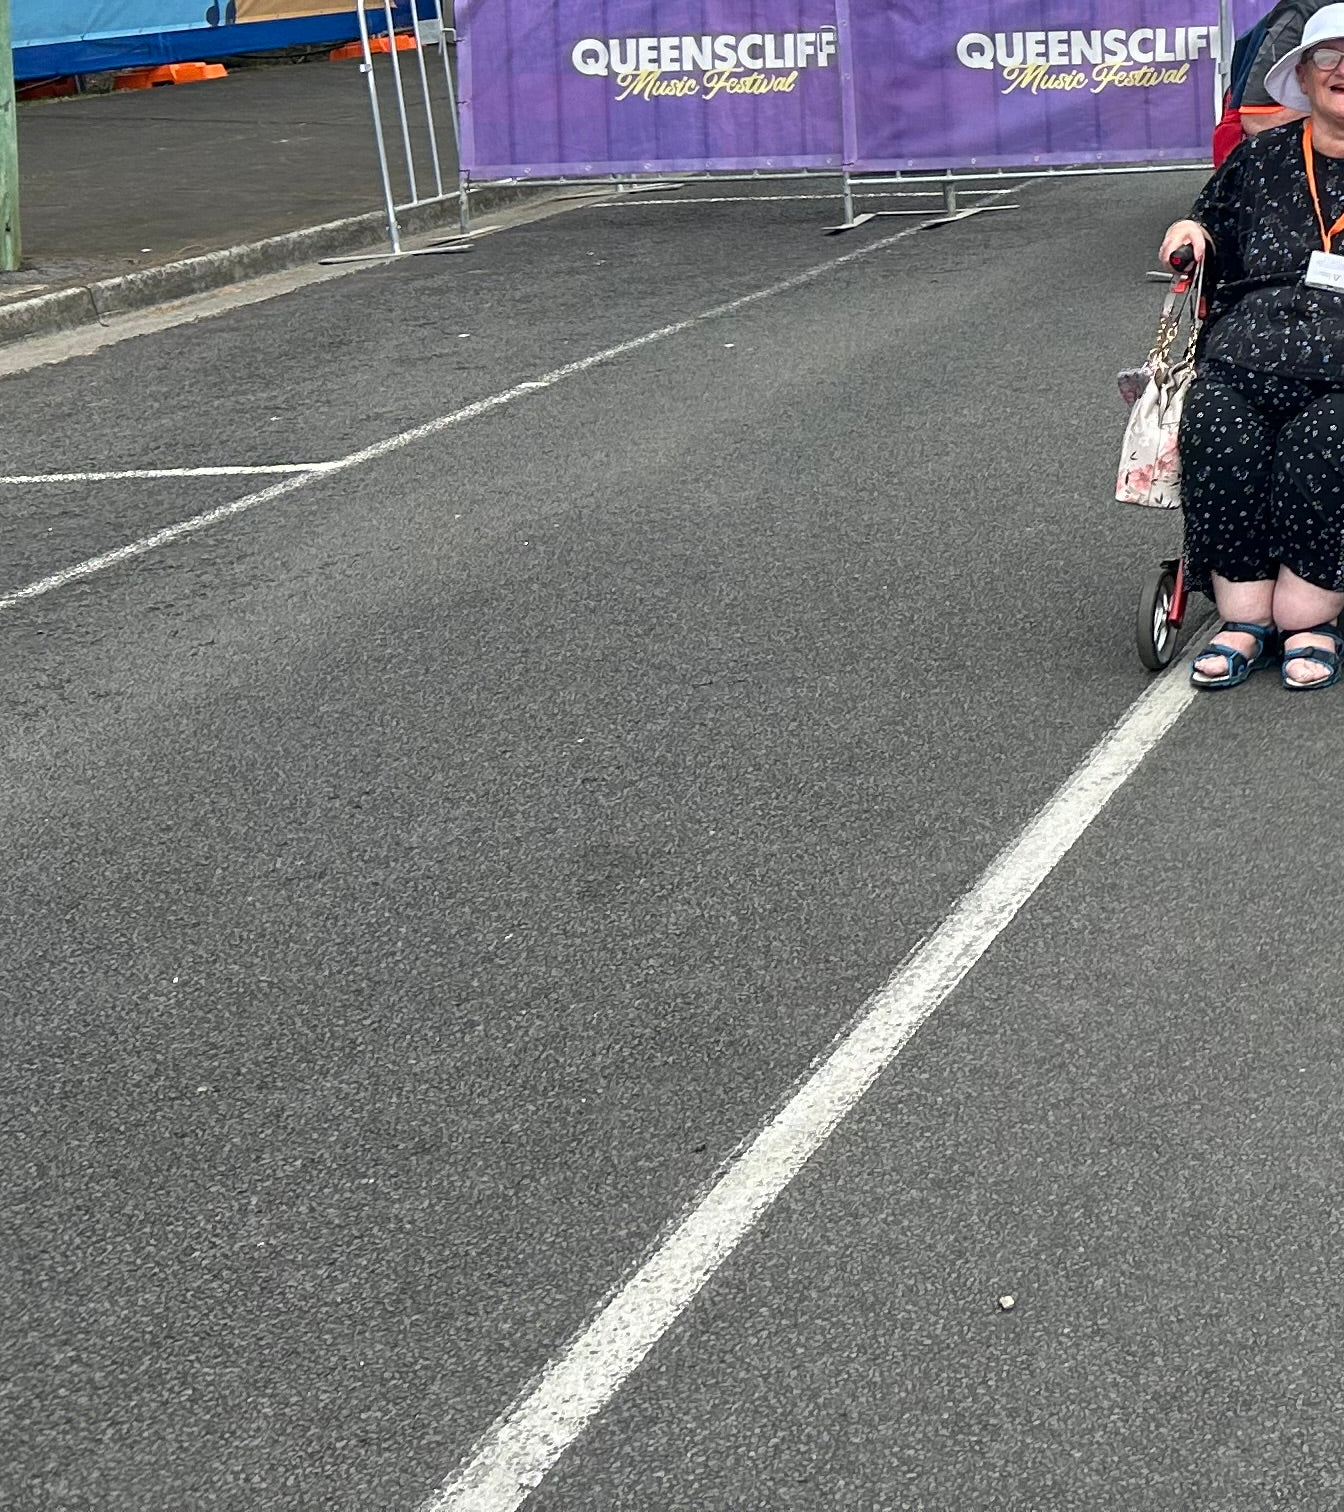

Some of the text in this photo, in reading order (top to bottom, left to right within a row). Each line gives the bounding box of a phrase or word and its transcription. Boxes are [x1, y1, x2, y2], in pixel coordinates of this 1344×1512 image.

[571, 32, 837, 76] QUEENSCLIFF
[615, 66, 799, 101] Music Festival
[1001, 59, 1188, 96] Music Festival
